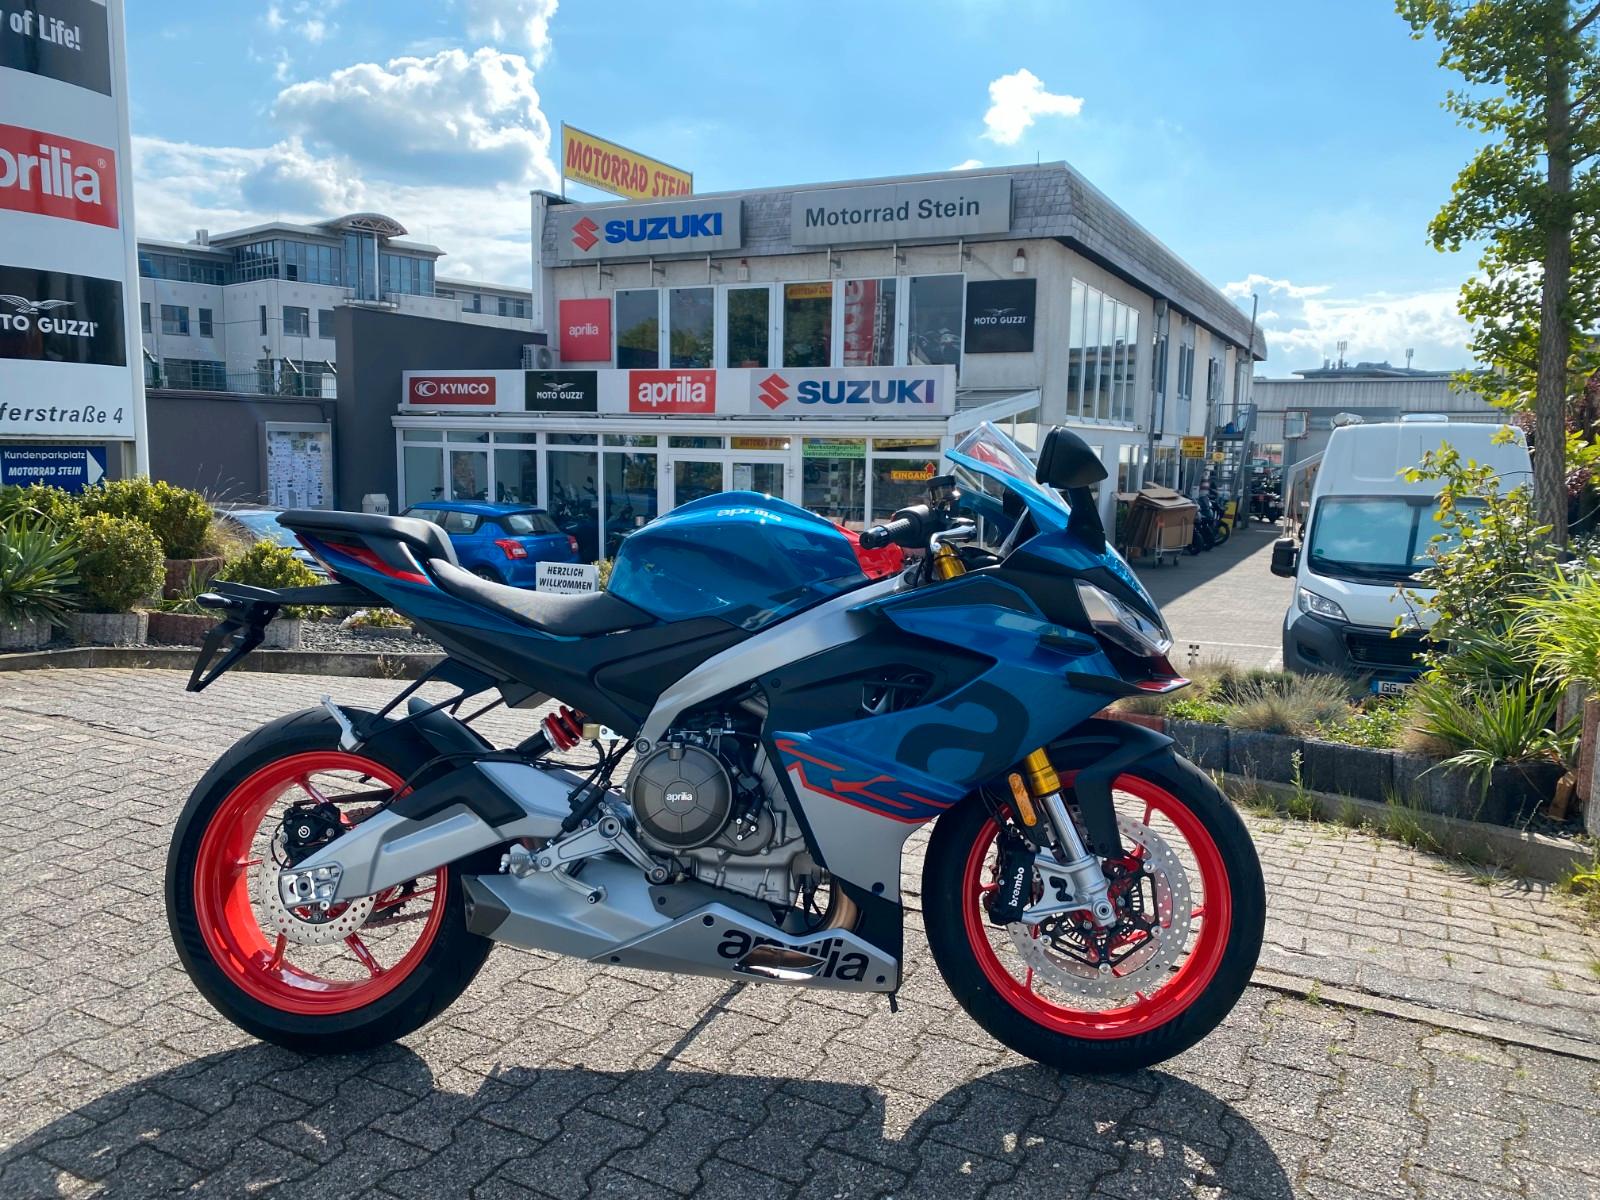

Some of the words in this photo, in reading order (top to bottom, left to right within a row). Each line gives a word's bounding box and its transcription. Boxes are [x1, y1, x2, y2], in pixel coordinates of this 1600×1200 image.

[10, 10, 33, 36] of
[38, 14, 81, 51] Life!
[566, 138, 648, 193] MOTORRAD
[651, 170, 690, 198] STEIN
[805, 200, 910, 228] Motorrad
[917, 196, 980, 219] Stein
[605, 212, 723, 244] SUZUKI
[37, 317, 96, 338] GUZZI
[974, 316, 998, 326] MOTO
[1000, 316, 1026, 324] GUZZI
[568, 323, 600, 338] aprilia
[440, 383, 490, 395] KYMCO
[536, 391, 558, 400] MOTO
[560, 391, 583, 400] GUZZI
[638, 376, 706, 407] aprilia
[797, 379, 936, 405] SUZUKI
[0, 402, 107, 423] ferstraße
[113, 407, 123, 424] 4
[4, 450, 86, 460] Kundenparkplatz
[8, 466, 56, 476] MOTORRAD
[57, 466, 82, 476] STEIN
[893, 472, 934, 480] EINGANG
[717, 508, 782, 522] aprilia
[547, 566, 584, 577] HERZLICH
[539, 577, 593, 590] WILLKOMMEN
[666, 791, 693, 803] aprilia
[1008, 866, 1025, 907] brembo
[717, 929, 870, 982] alia
